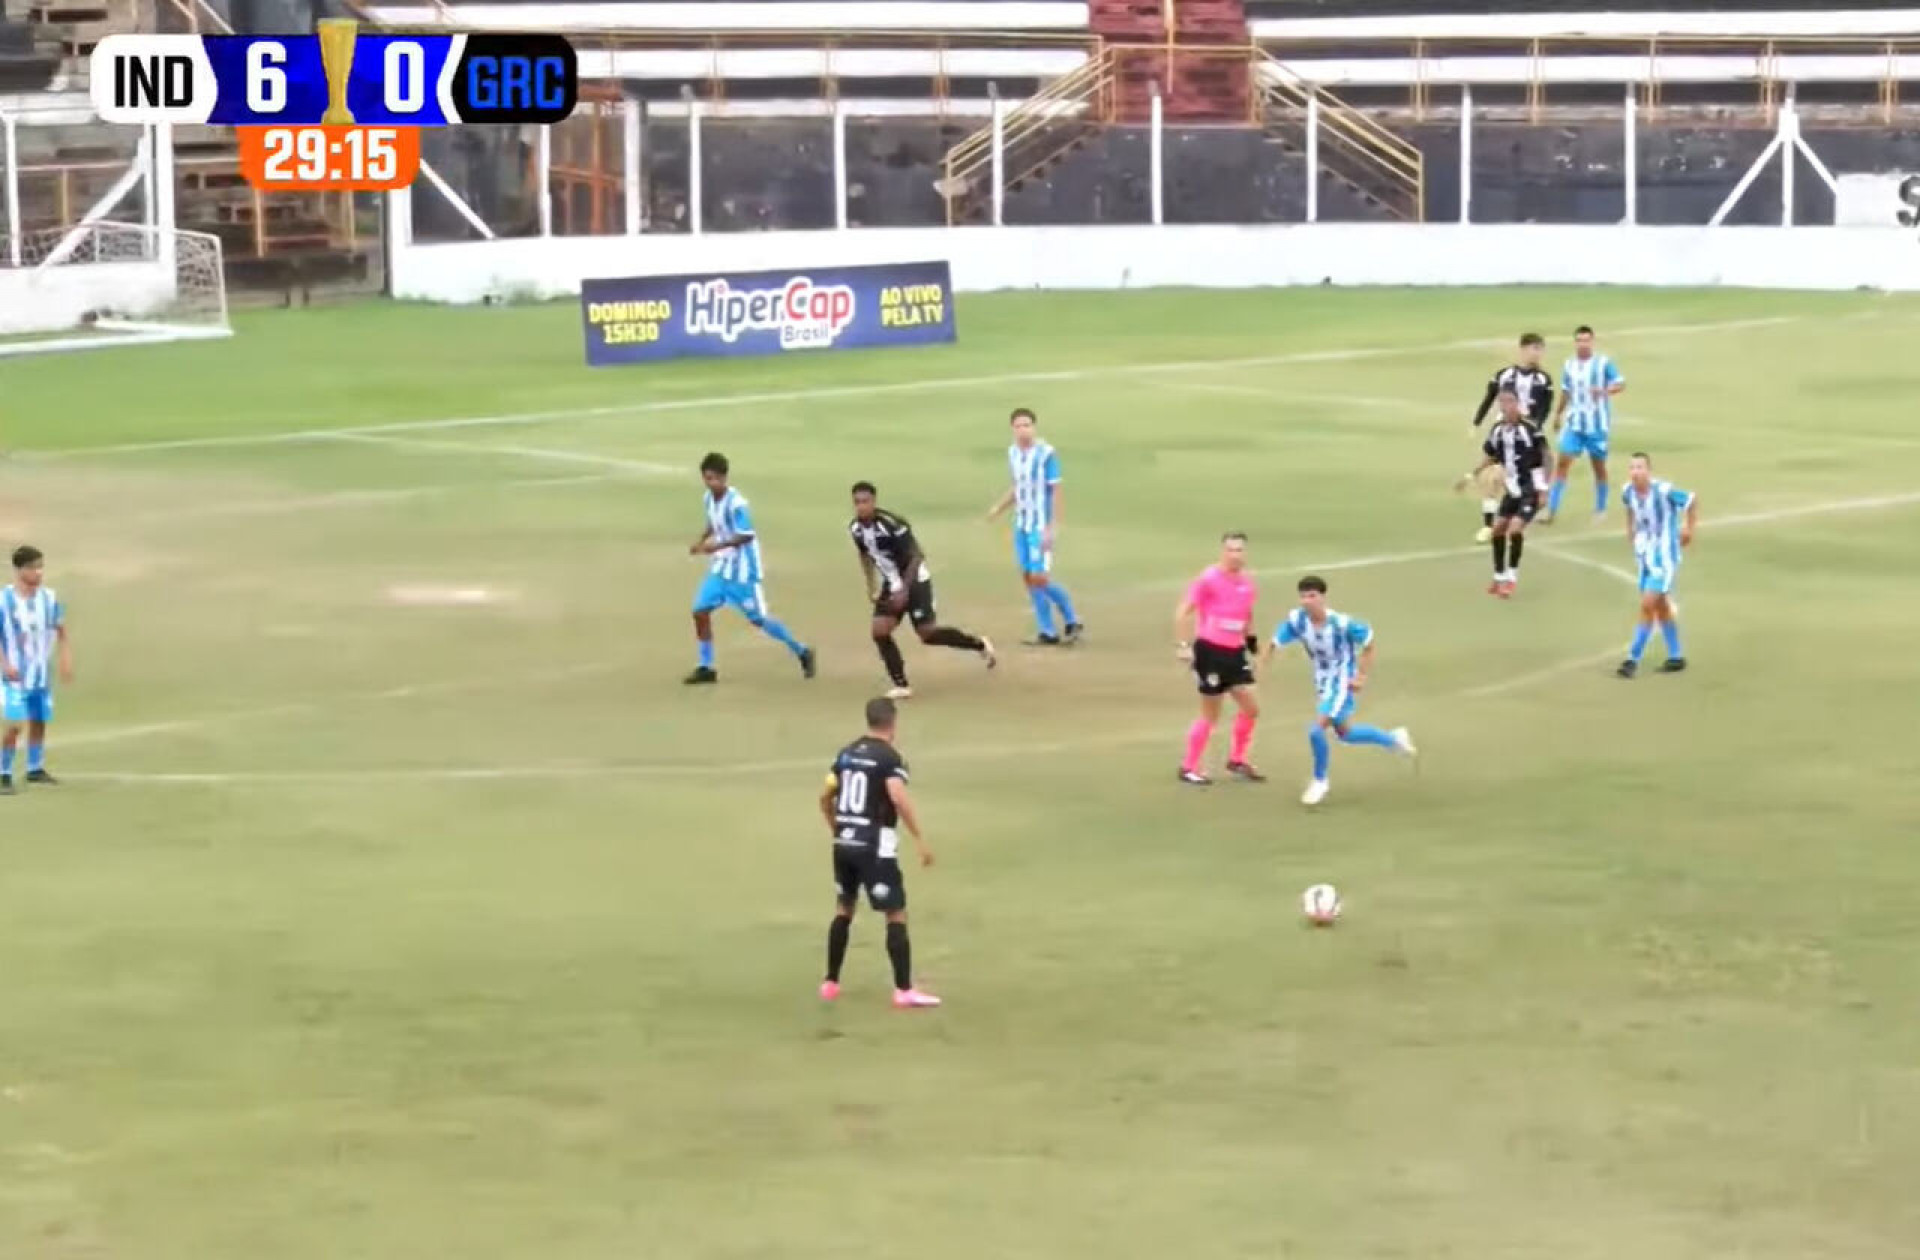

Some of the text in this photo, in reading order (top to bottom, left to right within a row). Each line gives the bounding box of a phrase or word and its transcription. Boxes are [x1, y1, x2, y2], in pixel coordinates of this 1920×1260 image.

[881, 284, 942, 306] AO VIVO
[588, 300, 670, 323] DOMINGO
[881, 303, 943, 327] PELA TV
[603, 322, 658, 344] 15H30
[784, 323, 829, 342] Brasil
[838, 770, 868, 814] 10
